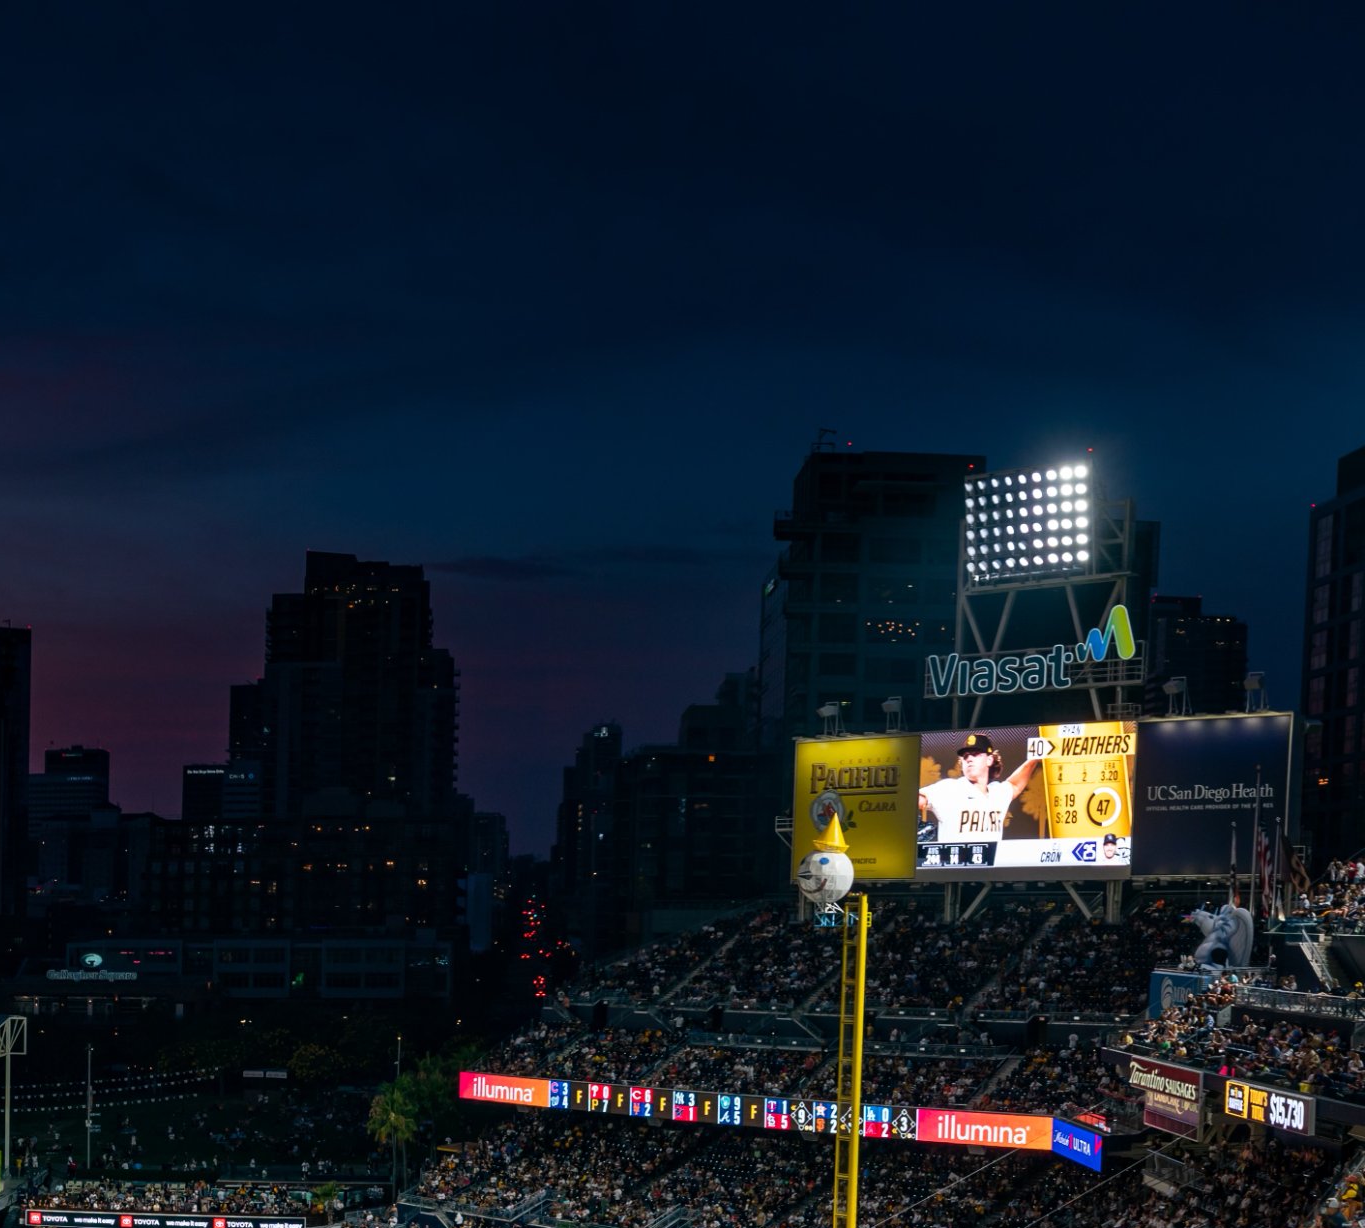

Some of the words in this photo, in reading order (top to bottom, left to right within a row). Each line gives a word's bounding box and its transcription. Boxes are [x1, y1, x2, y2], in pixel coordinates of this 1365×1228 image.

[928, 644, 1072, 697] Viasat
[1029, 740, 1044, 757] 40
[1061, 735, 1130, 756] WEATHERS
[810, 763, 900, 794] PACIFICO
[1100, 770, 1118, 782] 3.20
[1065, 794, 1076, 807] 19
[1147, 786, 1168, 800] UC
[1169, 785, 1192, 800] San
[1194, 784, 1230, 802] Diego
[858, 800, 896, 812] CLARA
[1097, 800, 1110, 815] 47
[1055, 812, 1064, 824] S:
[1065, 811, 1078, 824] 28
[1040, 852, 1061, 863] CRON
[47, 970, 98, 982] Gallagher
[99, 970, 137, 982] Square
[1129, 1061, 1165, 1092] Tarantino
[1165, 1078, 1196, 1100] SAUSAGES
[473, 1078, 533, 1102] illumina
[577, 1090, 582, 1103] F
[603, 1100, 609, 1112] 7
[1270, 1093, 1304, 1130] $15,730
[936, 1115, 1028, 1145] illumina
[1072, 1137, 1091, 1157] ULTRA
